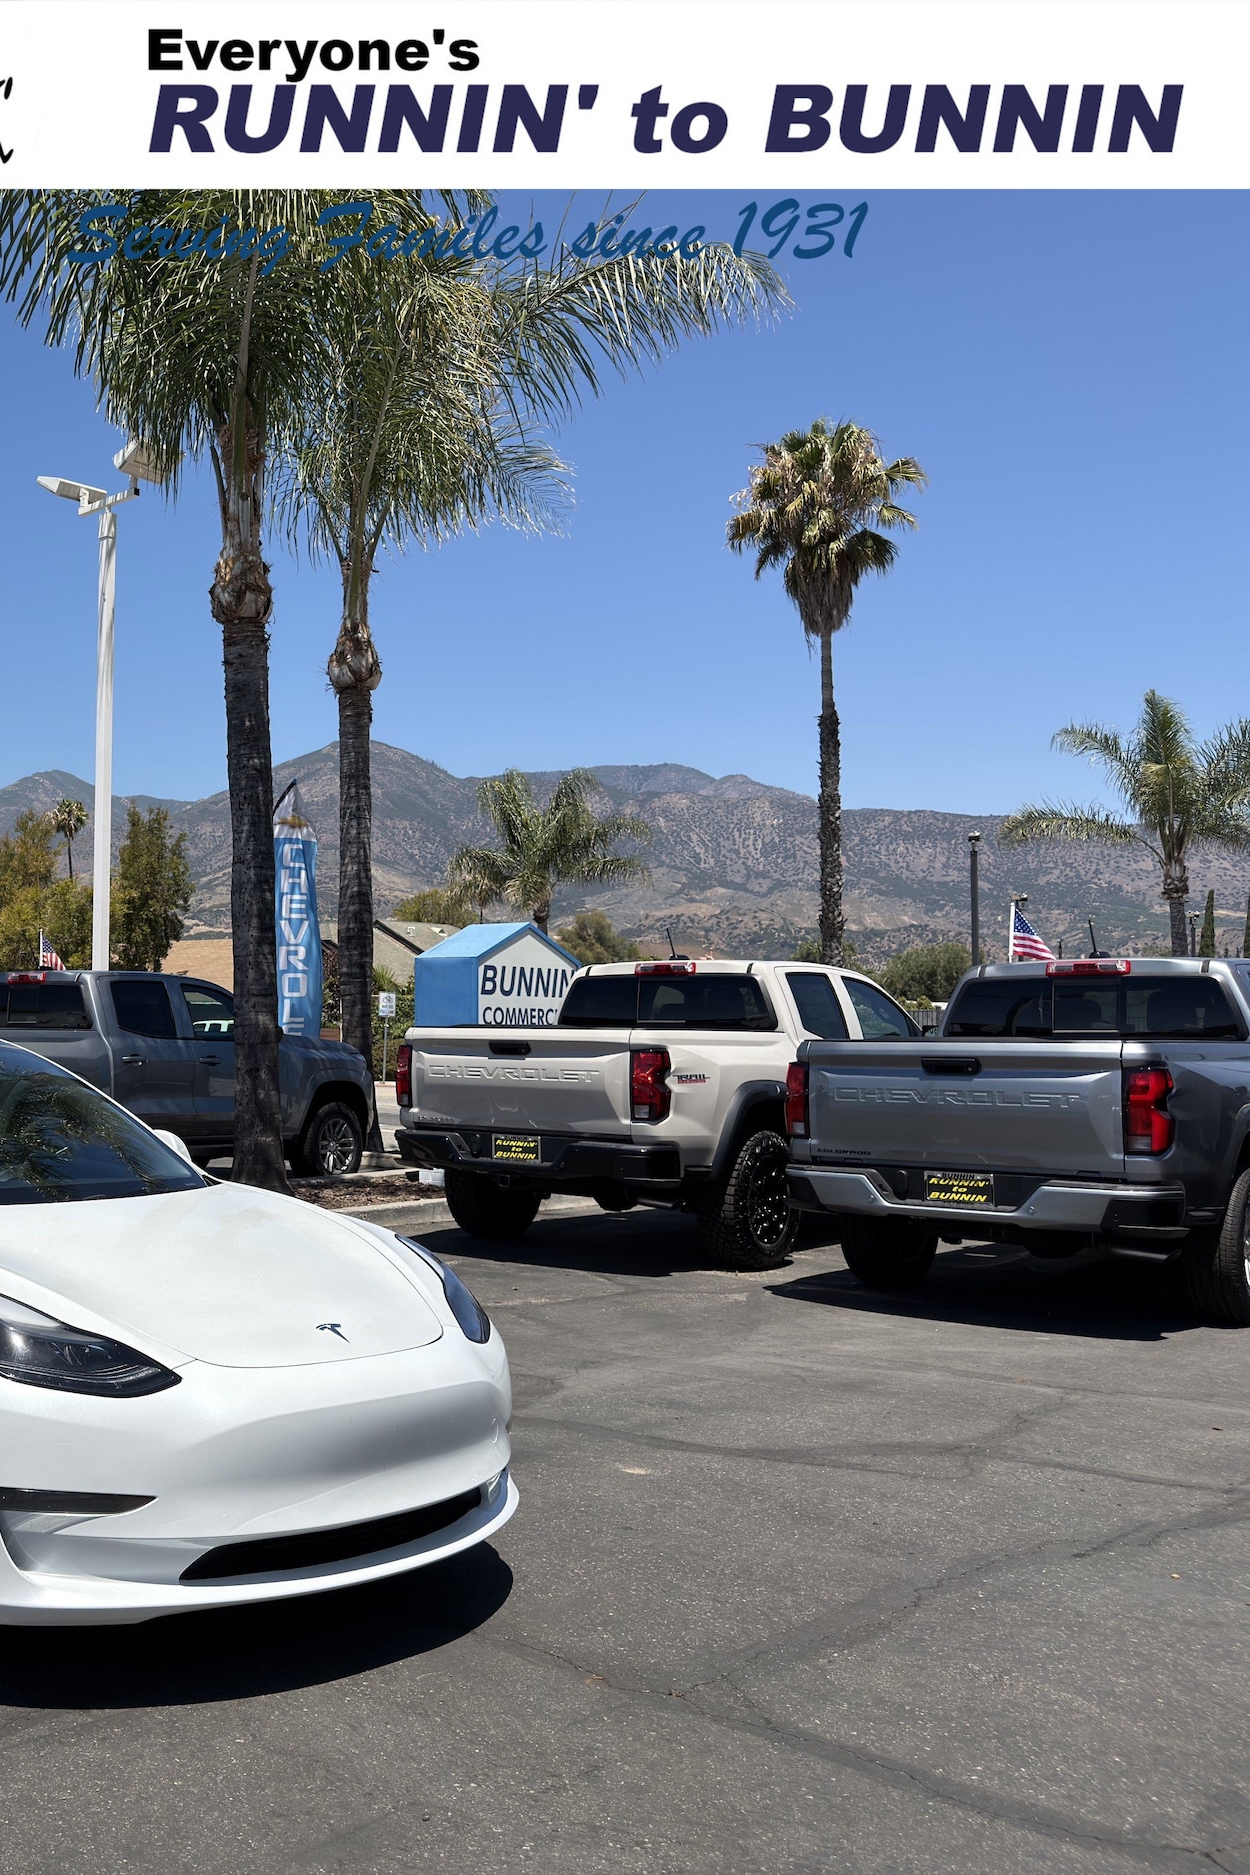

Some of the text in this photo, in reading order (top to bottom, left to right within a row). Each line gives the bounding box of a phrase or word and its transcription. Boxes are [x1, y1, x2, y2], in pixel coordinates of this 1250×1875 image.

[429, 1065, 600, 1082] CHEVROLET
[834, 1087, 1080, 1108] CHEVROLET
[495, 1151, 536, 1159] BUNNIN
[817, 1148, 871, 1156] COLORADO
[929, 1177, 990, 1187] RUNNIN'
[930, 1191, 987, 1202] BUNNIN
